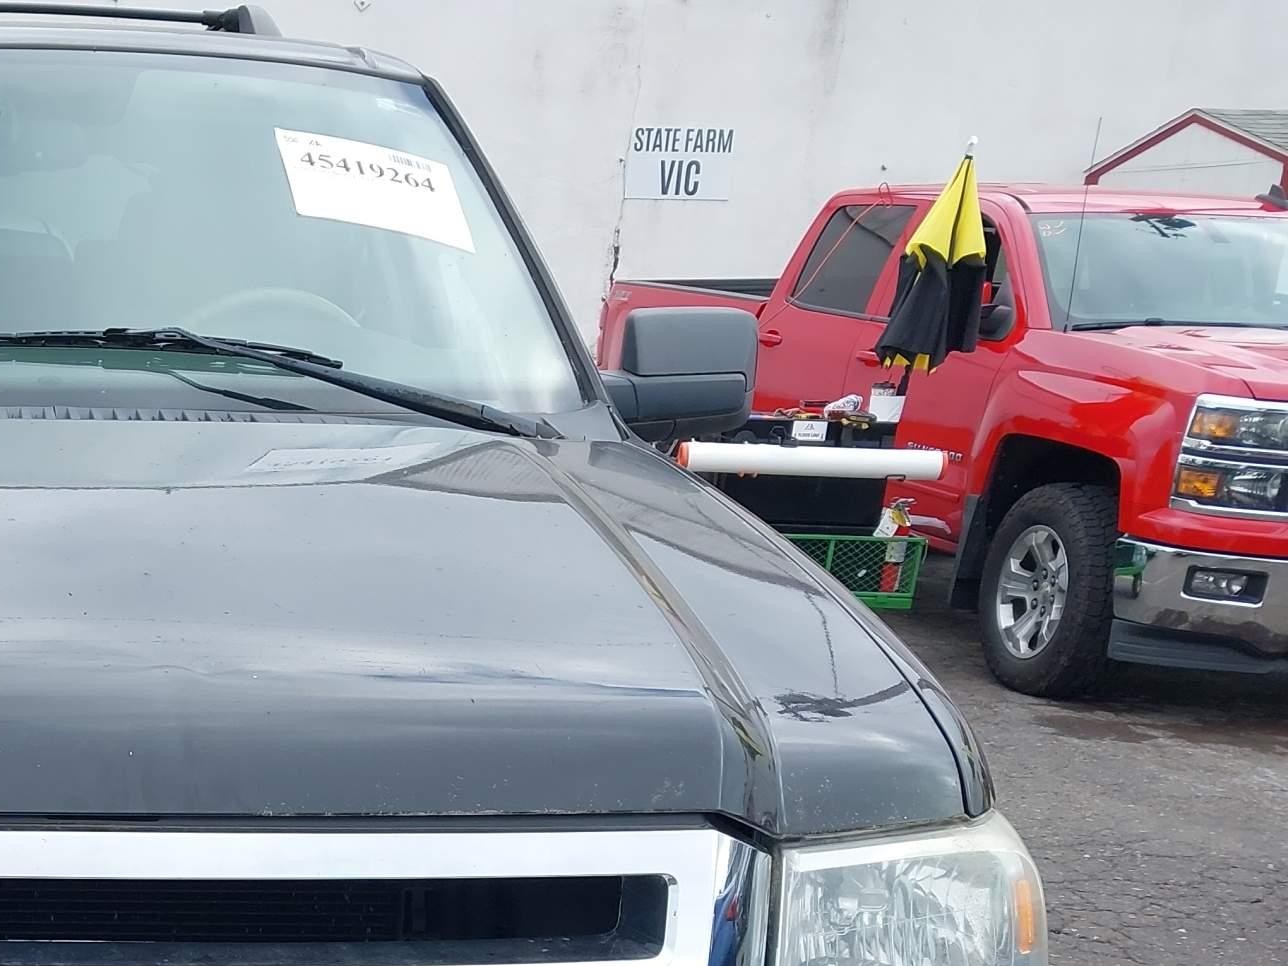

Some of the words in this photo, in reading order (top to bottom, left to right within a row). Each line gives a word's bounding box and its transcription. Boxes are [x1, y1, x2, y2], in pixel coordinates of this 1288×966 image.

[633, 127, 681, 153] STATE
[684, 128, 734, 153] FARM
[300, 151, 436, 192] 45419264
[660, 159, 701, 196] VIC
